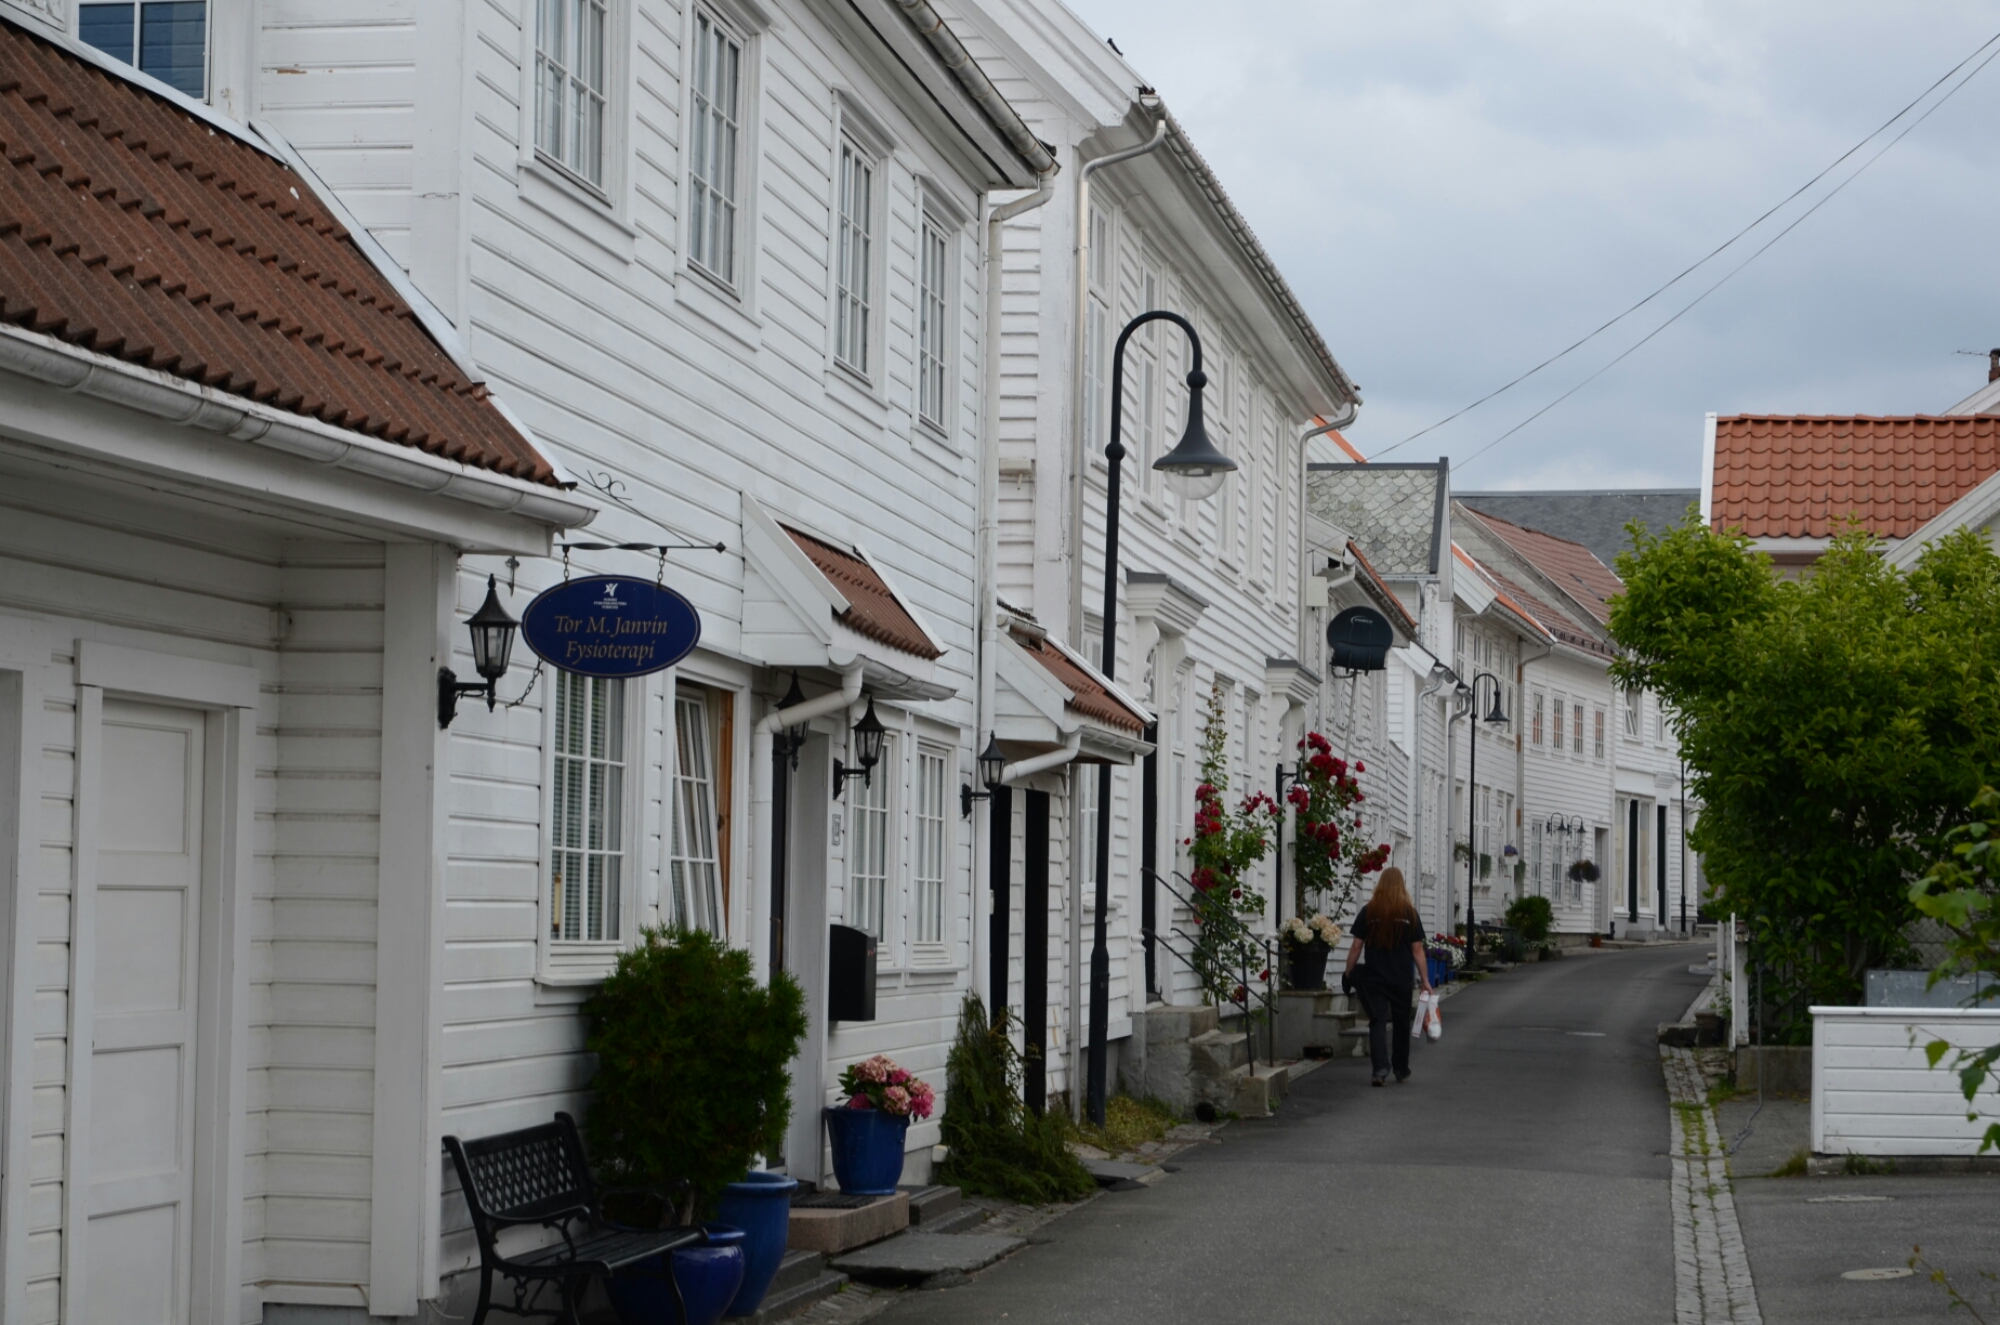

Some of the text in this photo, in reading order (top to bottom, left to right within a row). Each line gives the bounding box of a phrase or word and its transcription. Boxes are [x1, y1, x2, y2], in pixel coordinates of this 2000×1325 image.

[554, 615, 668, 638] Tor M. Janvin
[566, 640, 655, 667] Fysioterapi
